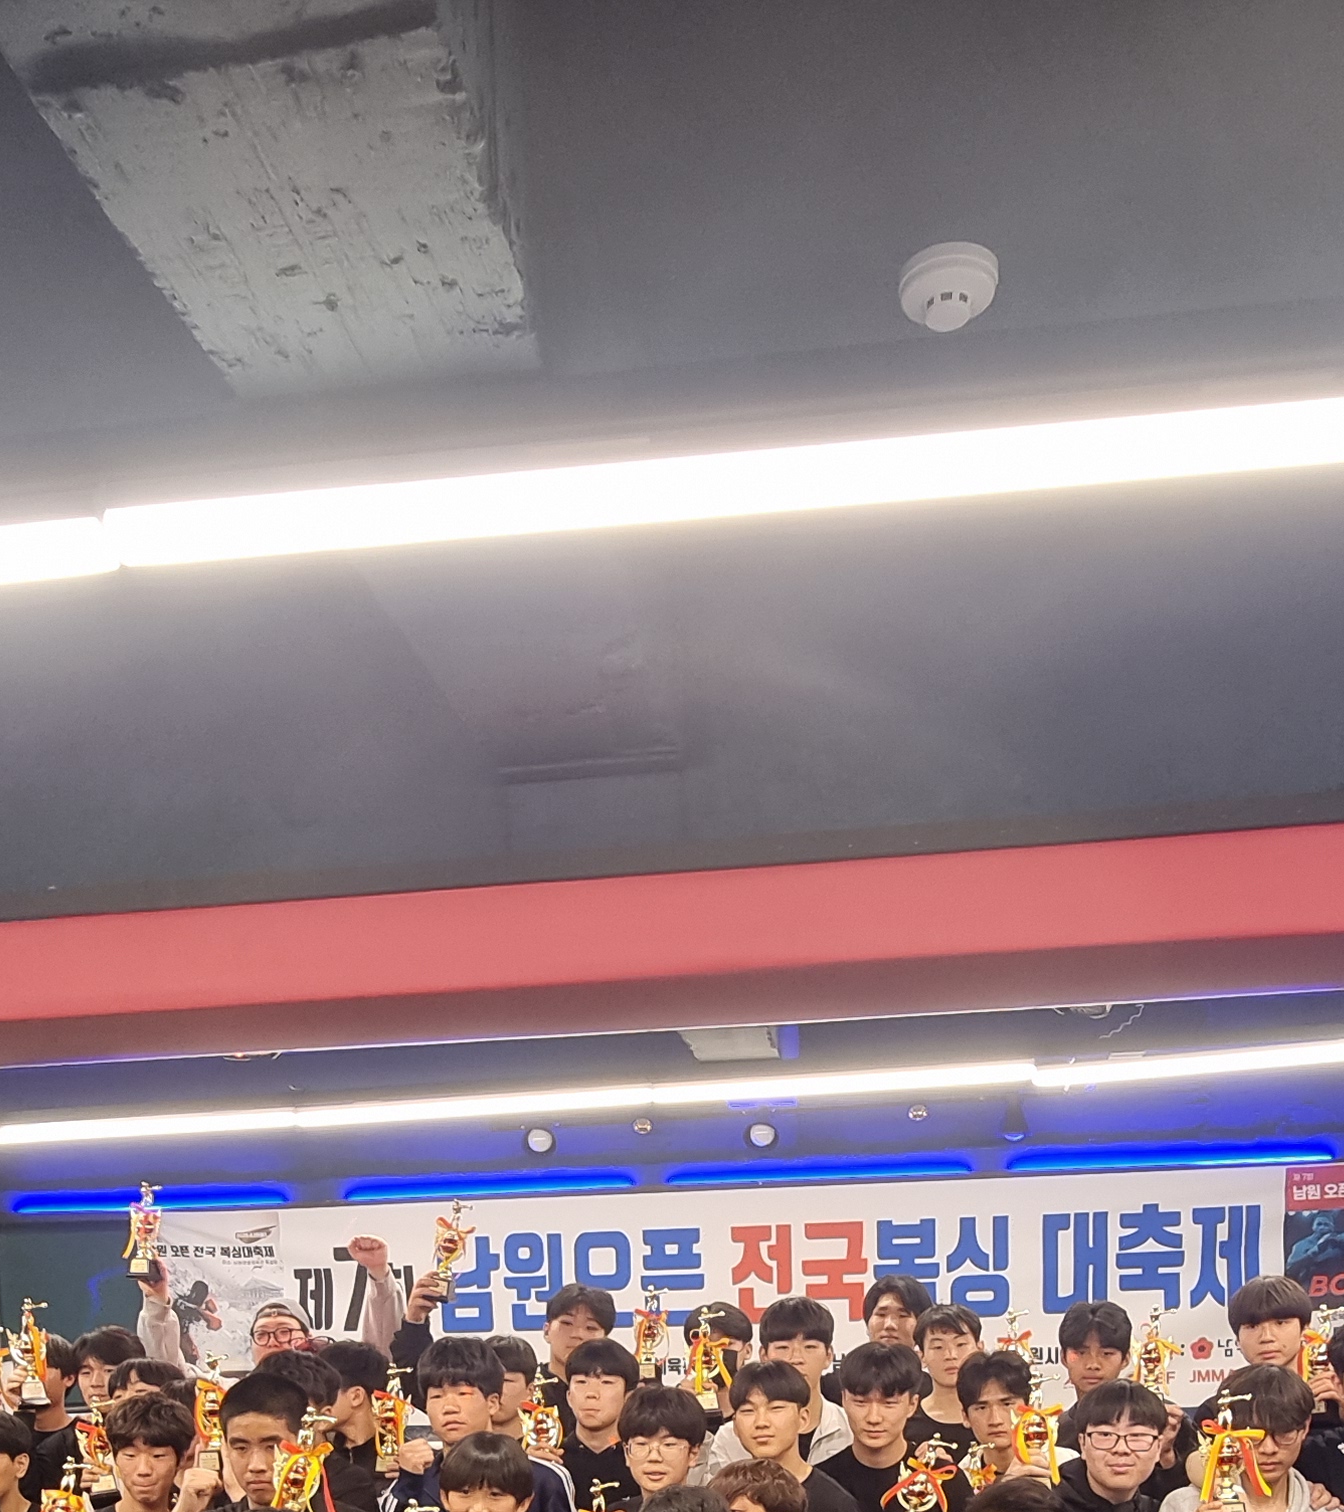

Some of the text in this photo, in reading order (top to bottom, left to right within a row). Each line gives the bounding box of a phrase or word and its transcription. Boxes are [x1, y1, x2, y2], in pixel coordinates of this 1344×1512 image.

[1292, 1184, 1321, 1200] 남원
[170, 1245, 191, 1258] 오픈
[193, 1245, 216, 1259] 전국
[220, 1245, 275, 1259] 복싱대축제
[439, 1228, 704, 1334] 남원오픈
[730, 1215, 1010, 1324] 전국복싱
[1042, 1203, 1262, 1315] 대축제
[1031, 1346, 1060, 1365] 원시
